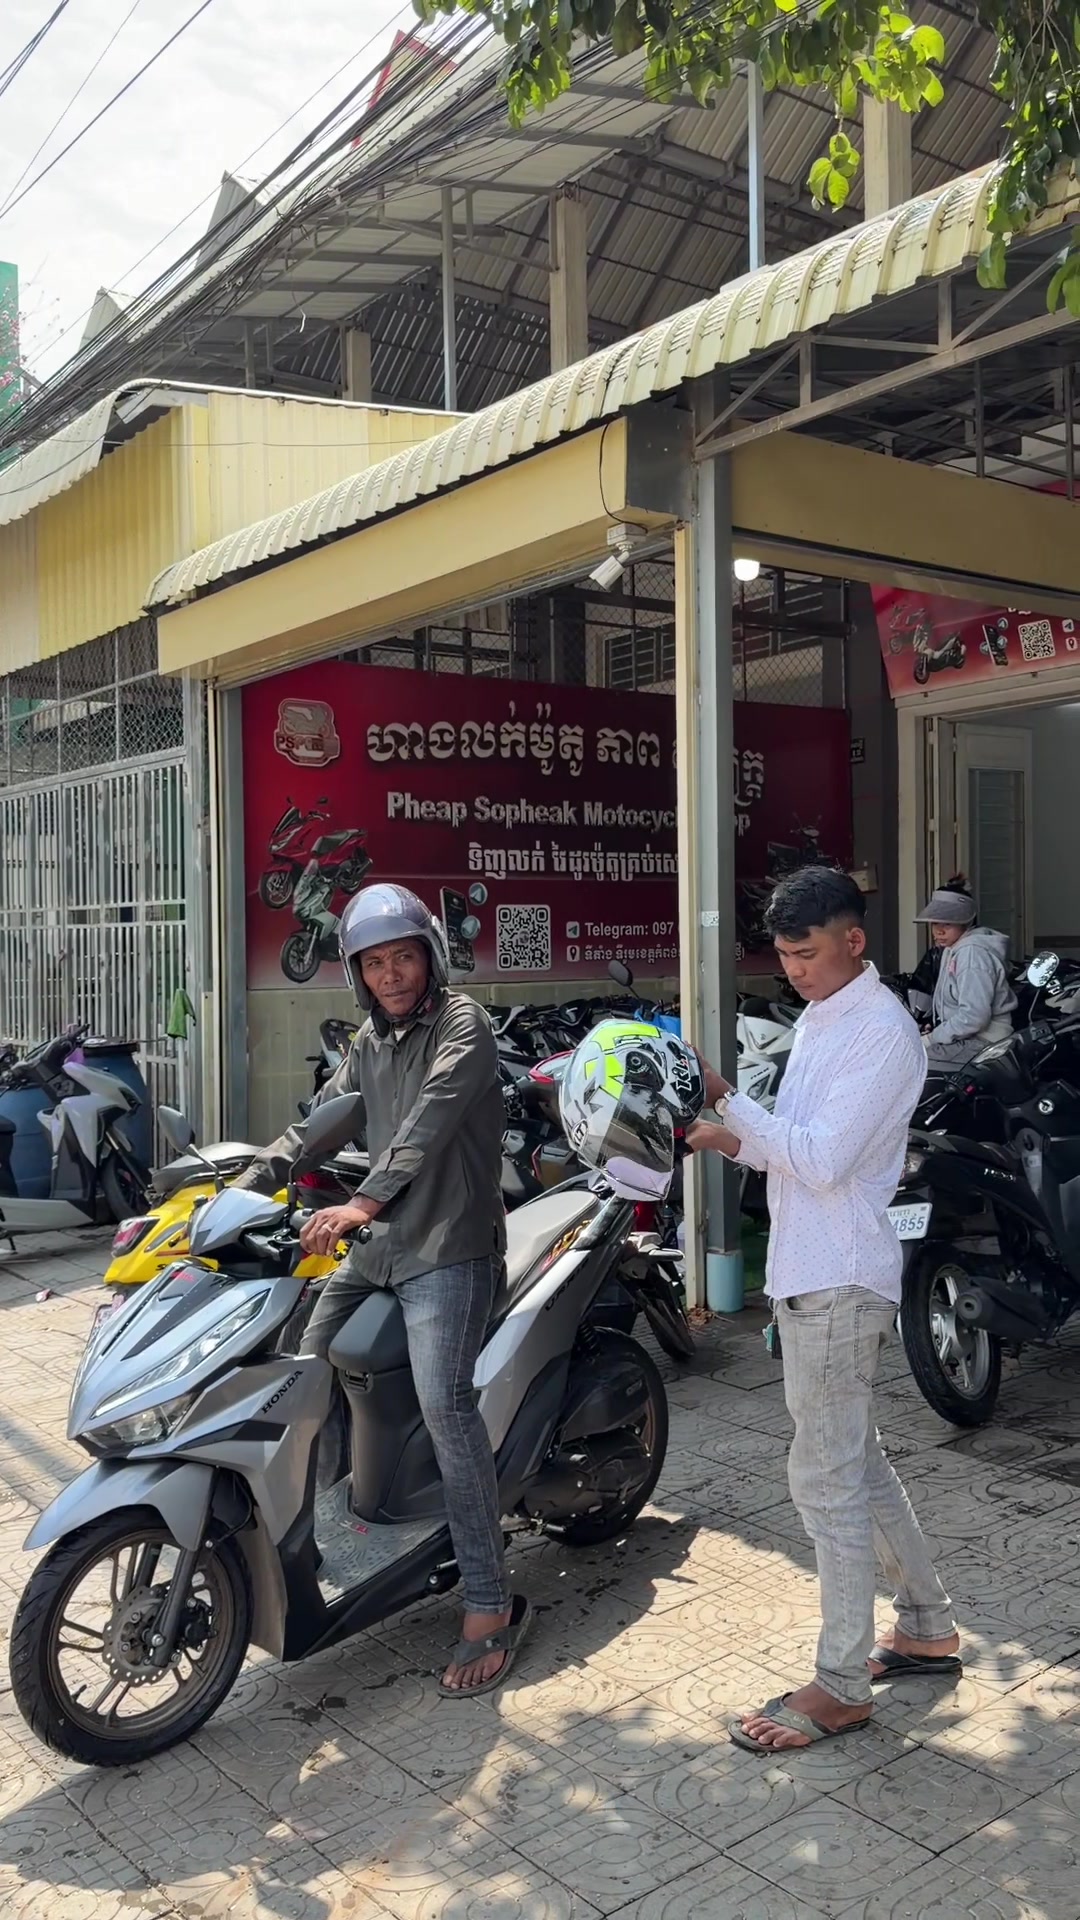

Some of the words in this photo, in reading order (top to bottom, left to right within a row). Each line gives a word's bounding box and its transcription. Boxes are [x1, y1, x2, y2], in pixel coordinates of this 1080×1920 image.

[386, 791, 467, 828] Pheap
[474, 795, 578, 830] Sopheak
[583, 801, 678, 835] Motocycl
[468, 840, 545, 879] ទិញលក់
[585, 922, 648, 939] Telegram:
[652, 921, 674, 935] 097
[260, 1369, 304, 1415] HONDA
